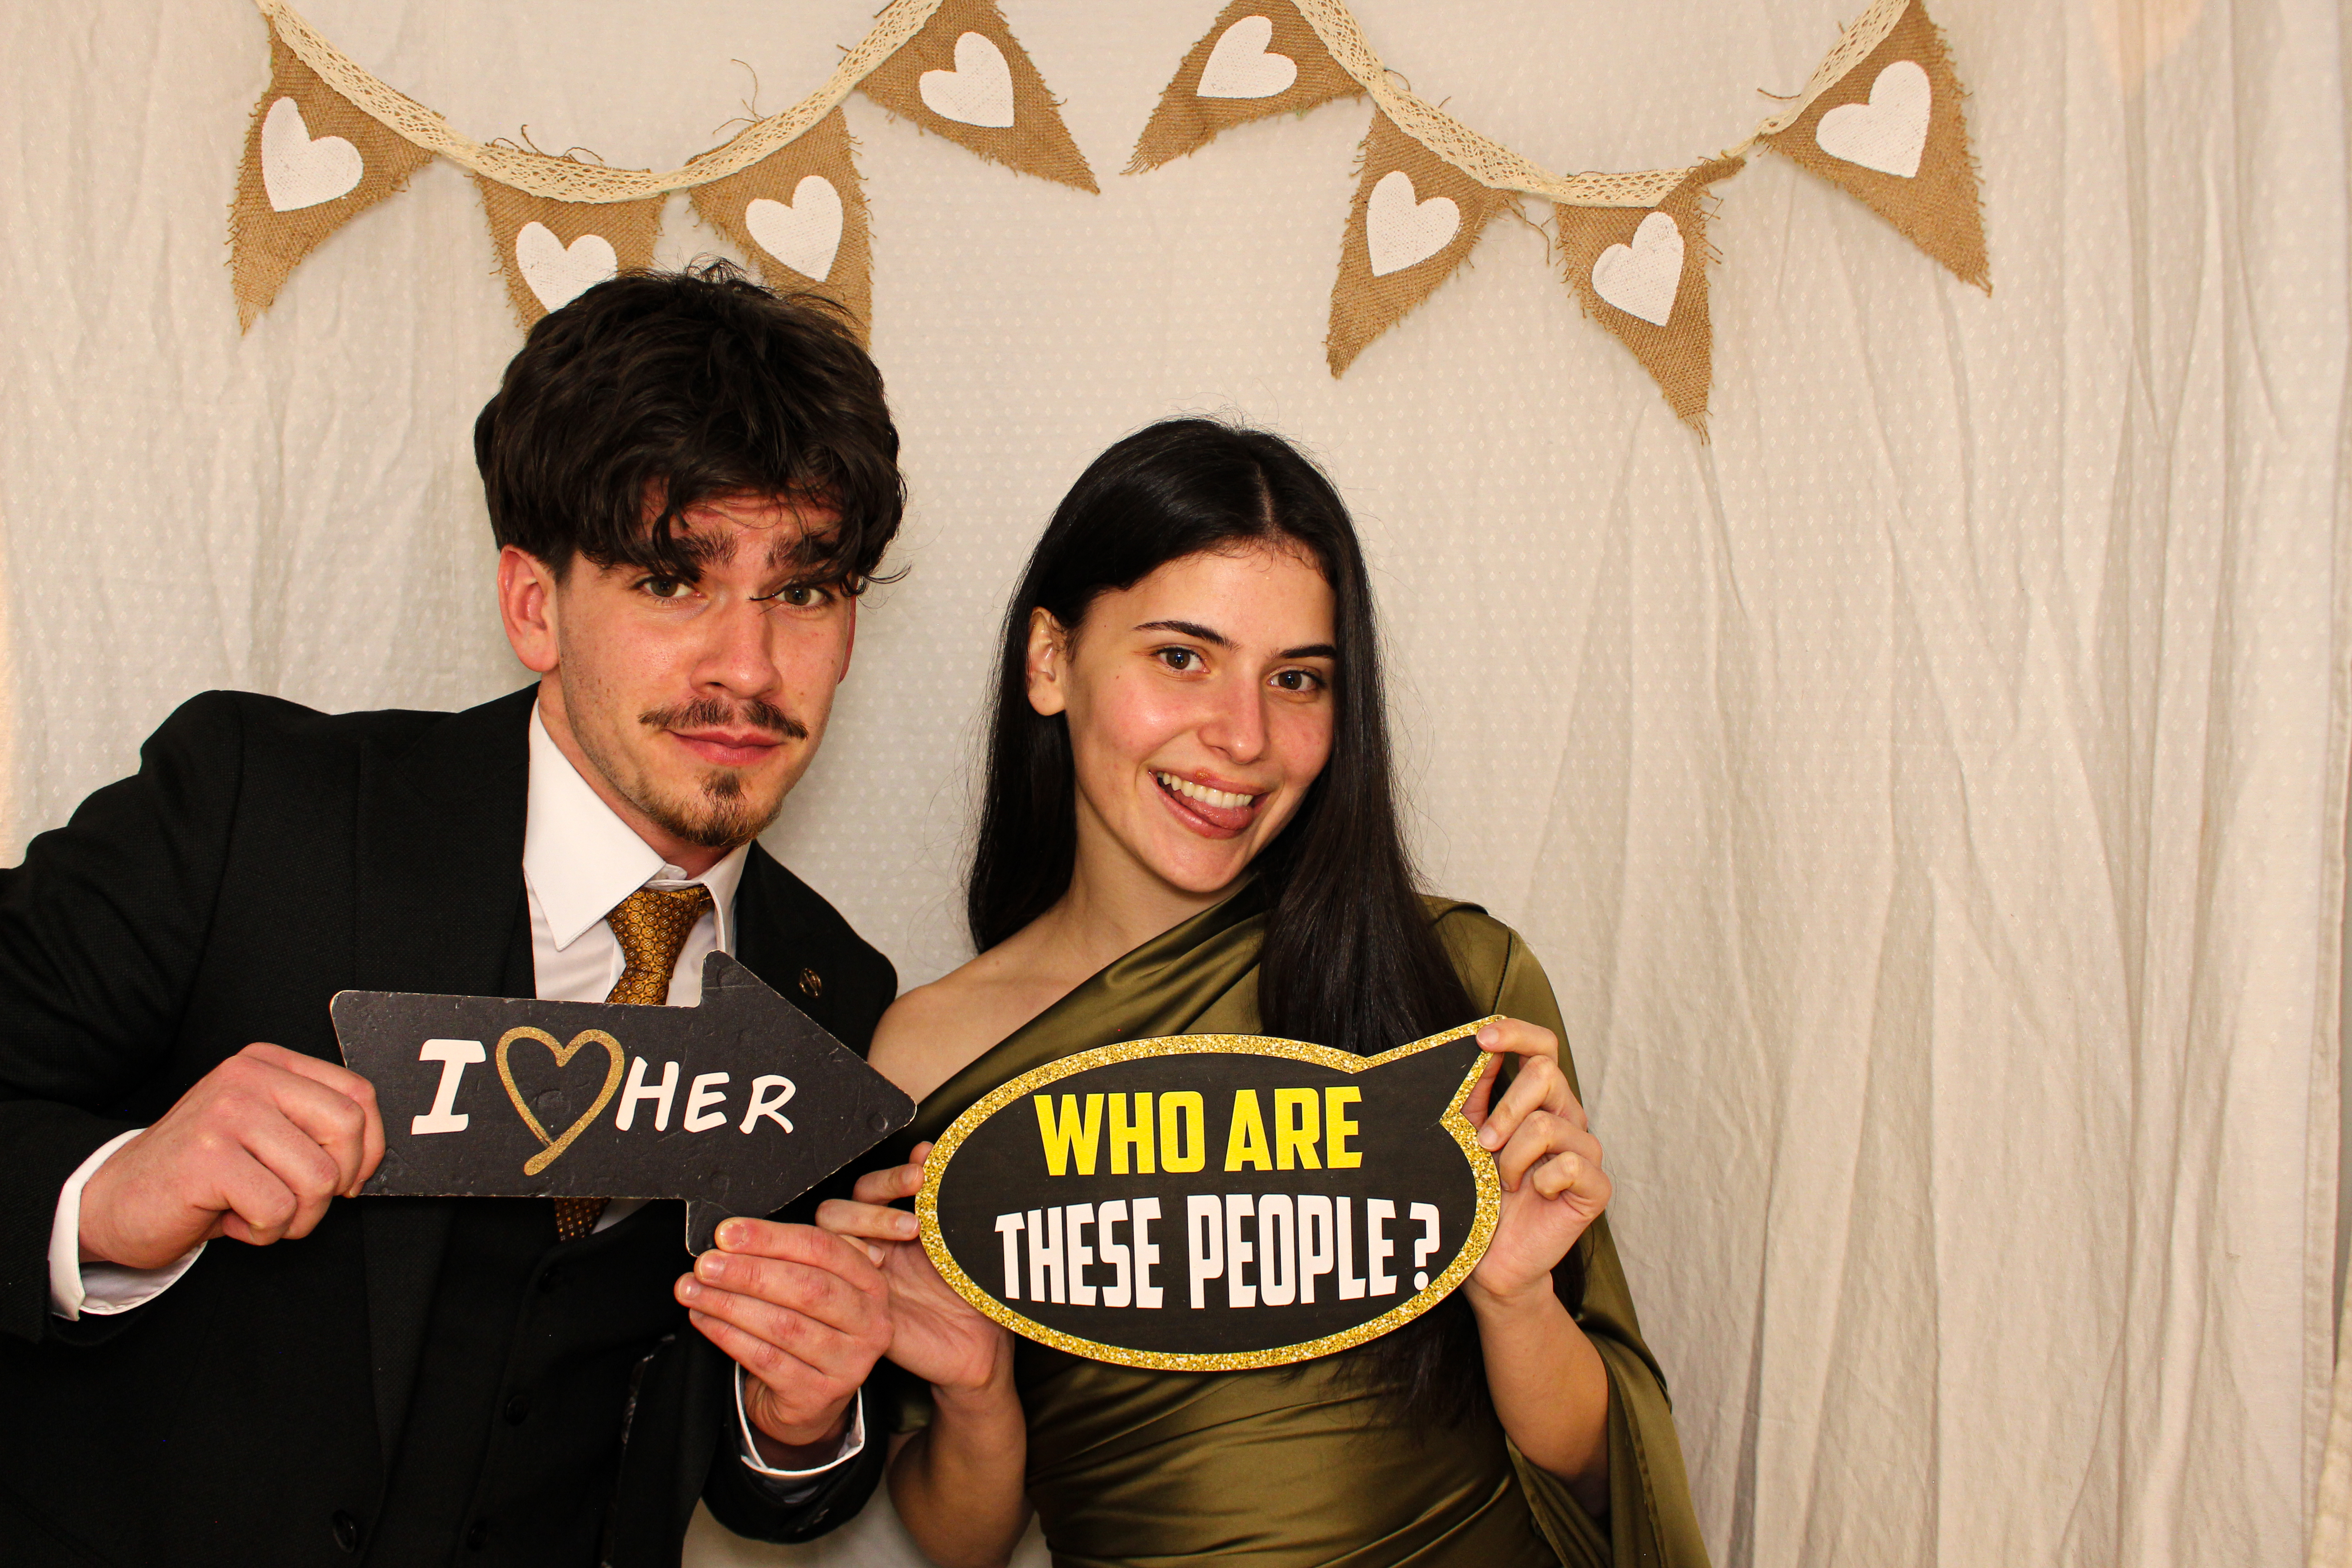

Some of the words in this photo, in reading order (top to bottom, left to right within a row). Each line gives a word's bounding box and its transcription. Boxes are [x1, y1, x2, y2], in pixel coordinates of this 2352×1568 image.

[411, 1038, 487, 1135] I
[615, 1055, 797, 1135] HER
[1034, 1090, 1206, 1176] WHO
[1224, 1086, 1363, 1172] ARE
[994, 1196, 1164, 1309] THESE
